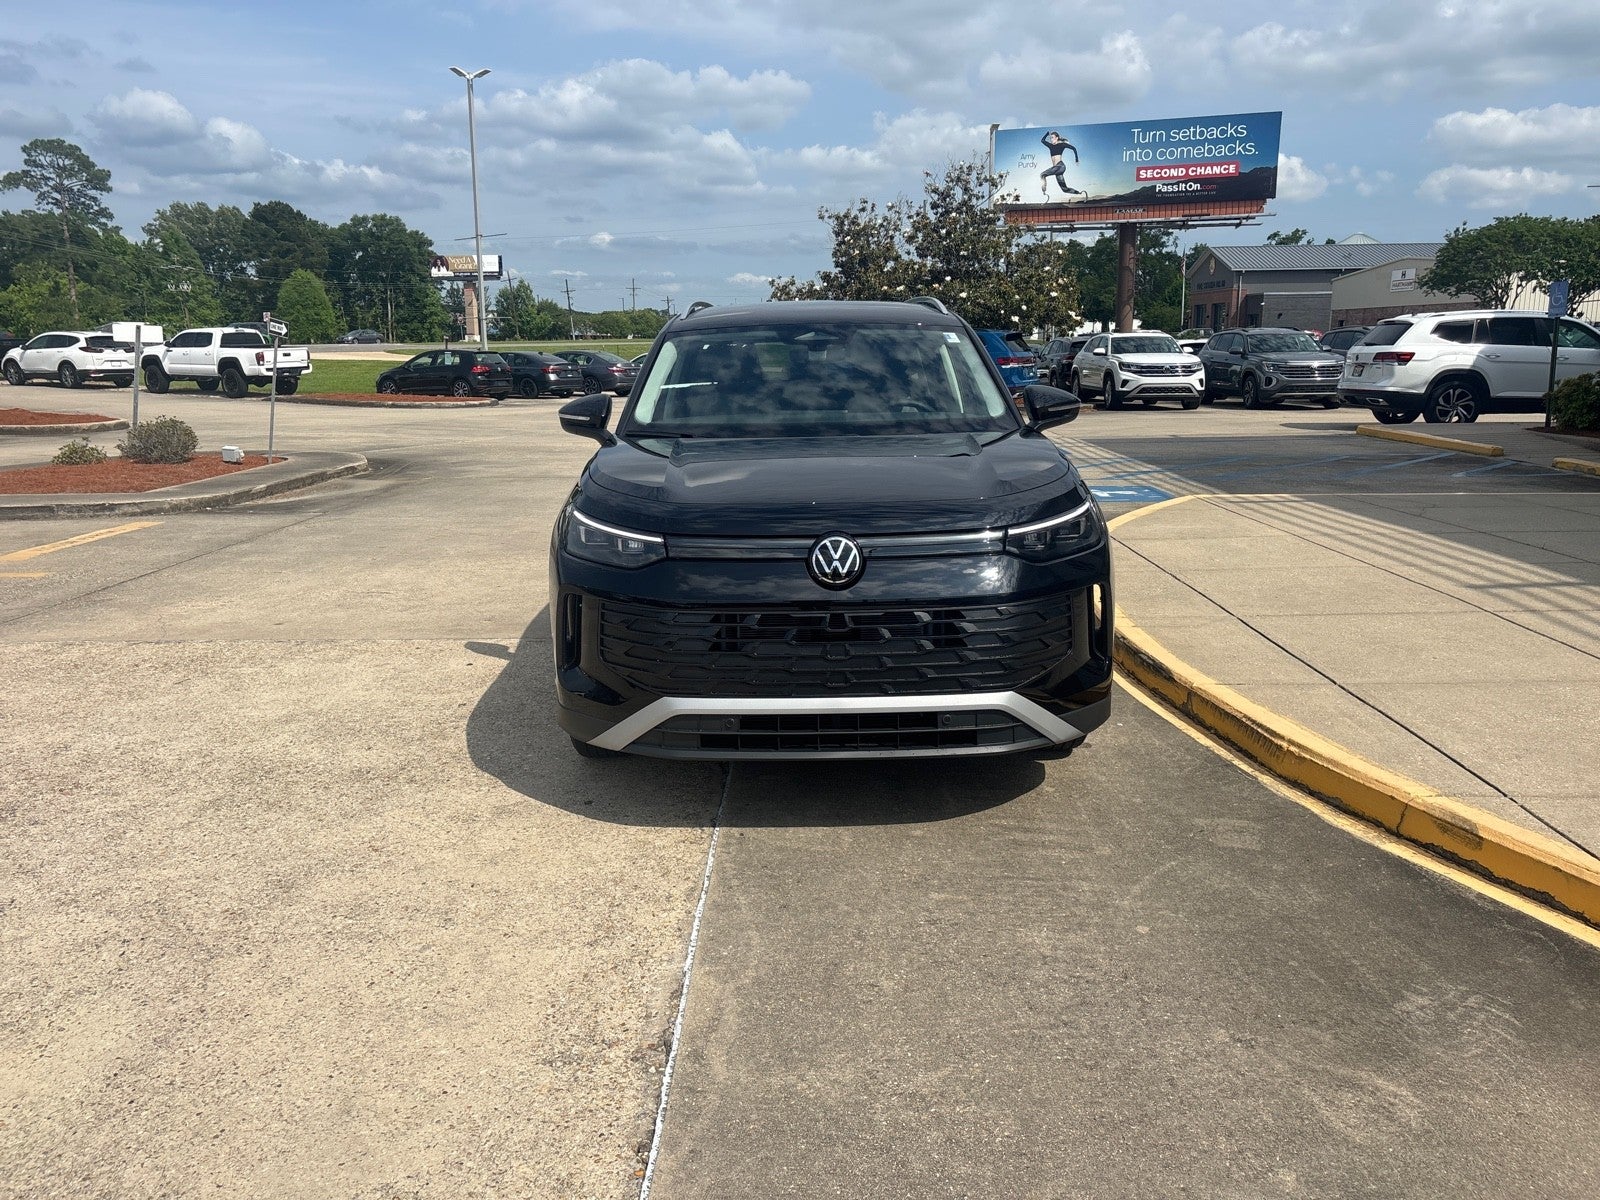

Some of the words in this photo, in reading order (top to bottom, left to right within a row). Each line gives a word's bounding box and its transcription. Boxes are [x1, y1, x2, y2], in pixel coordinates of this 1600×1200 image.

[1130, 128, 1166, 144] Turn
[1169, 122, 1247, 142] setbacks
[1020, 153, 1036, 161] Amy
[1122, 146, 1153, 162] into
[1156, 140, 1259, 161] comebacks.
[1017, 161, 1038, 169] Purdy
[1139, 167, 1187, 179] SECOND
[1188, 164, 1237, 176] CHANCE
[1155, 181, 1217, 193] PassItOn.com
[448, 256, 466, 264] Need
[812, 536, 860, 583] VW
